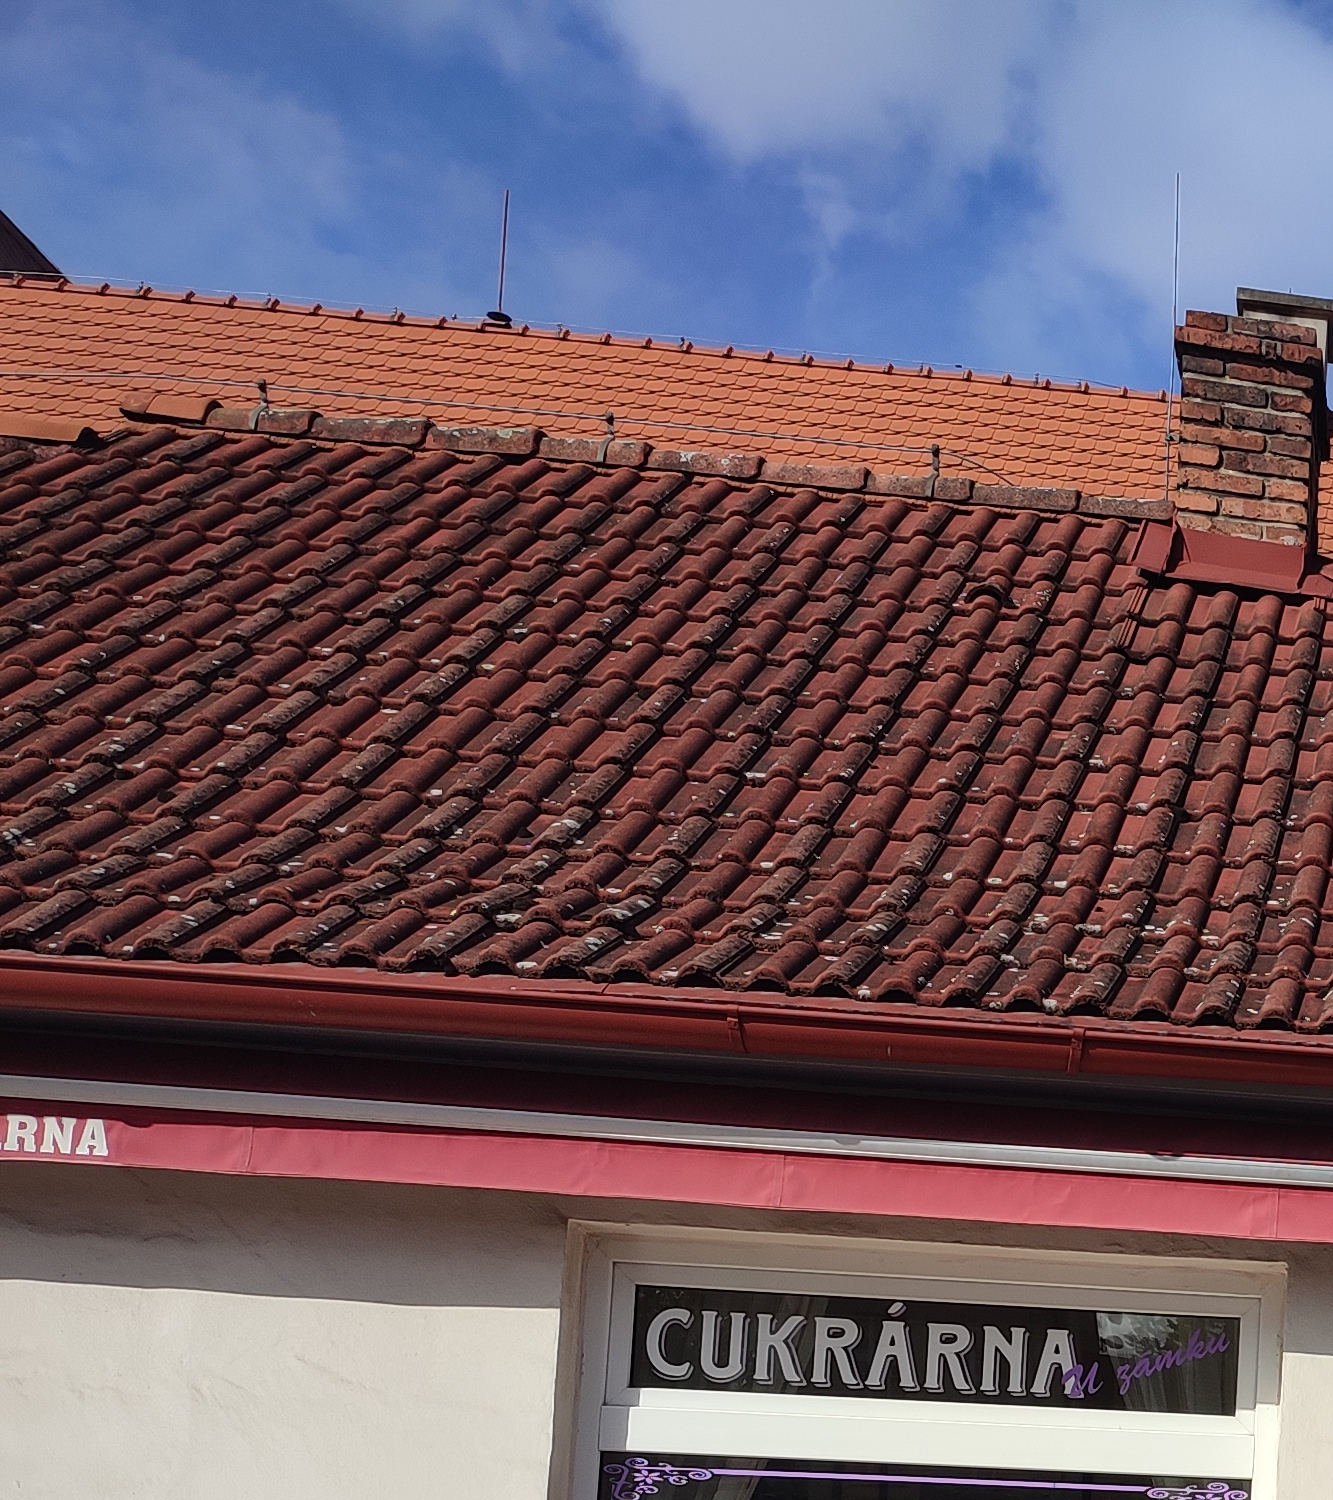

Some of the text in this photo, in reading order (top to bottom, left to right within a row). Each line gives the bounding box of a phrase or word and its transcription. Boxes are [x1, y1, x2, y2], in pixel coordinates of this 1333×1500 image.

[0, 1114, 109, 1157] RNA
[645, 1302, 1084, 1398] CUKRÁRNA
[1116, 1328, 1231, 1396] zámku
